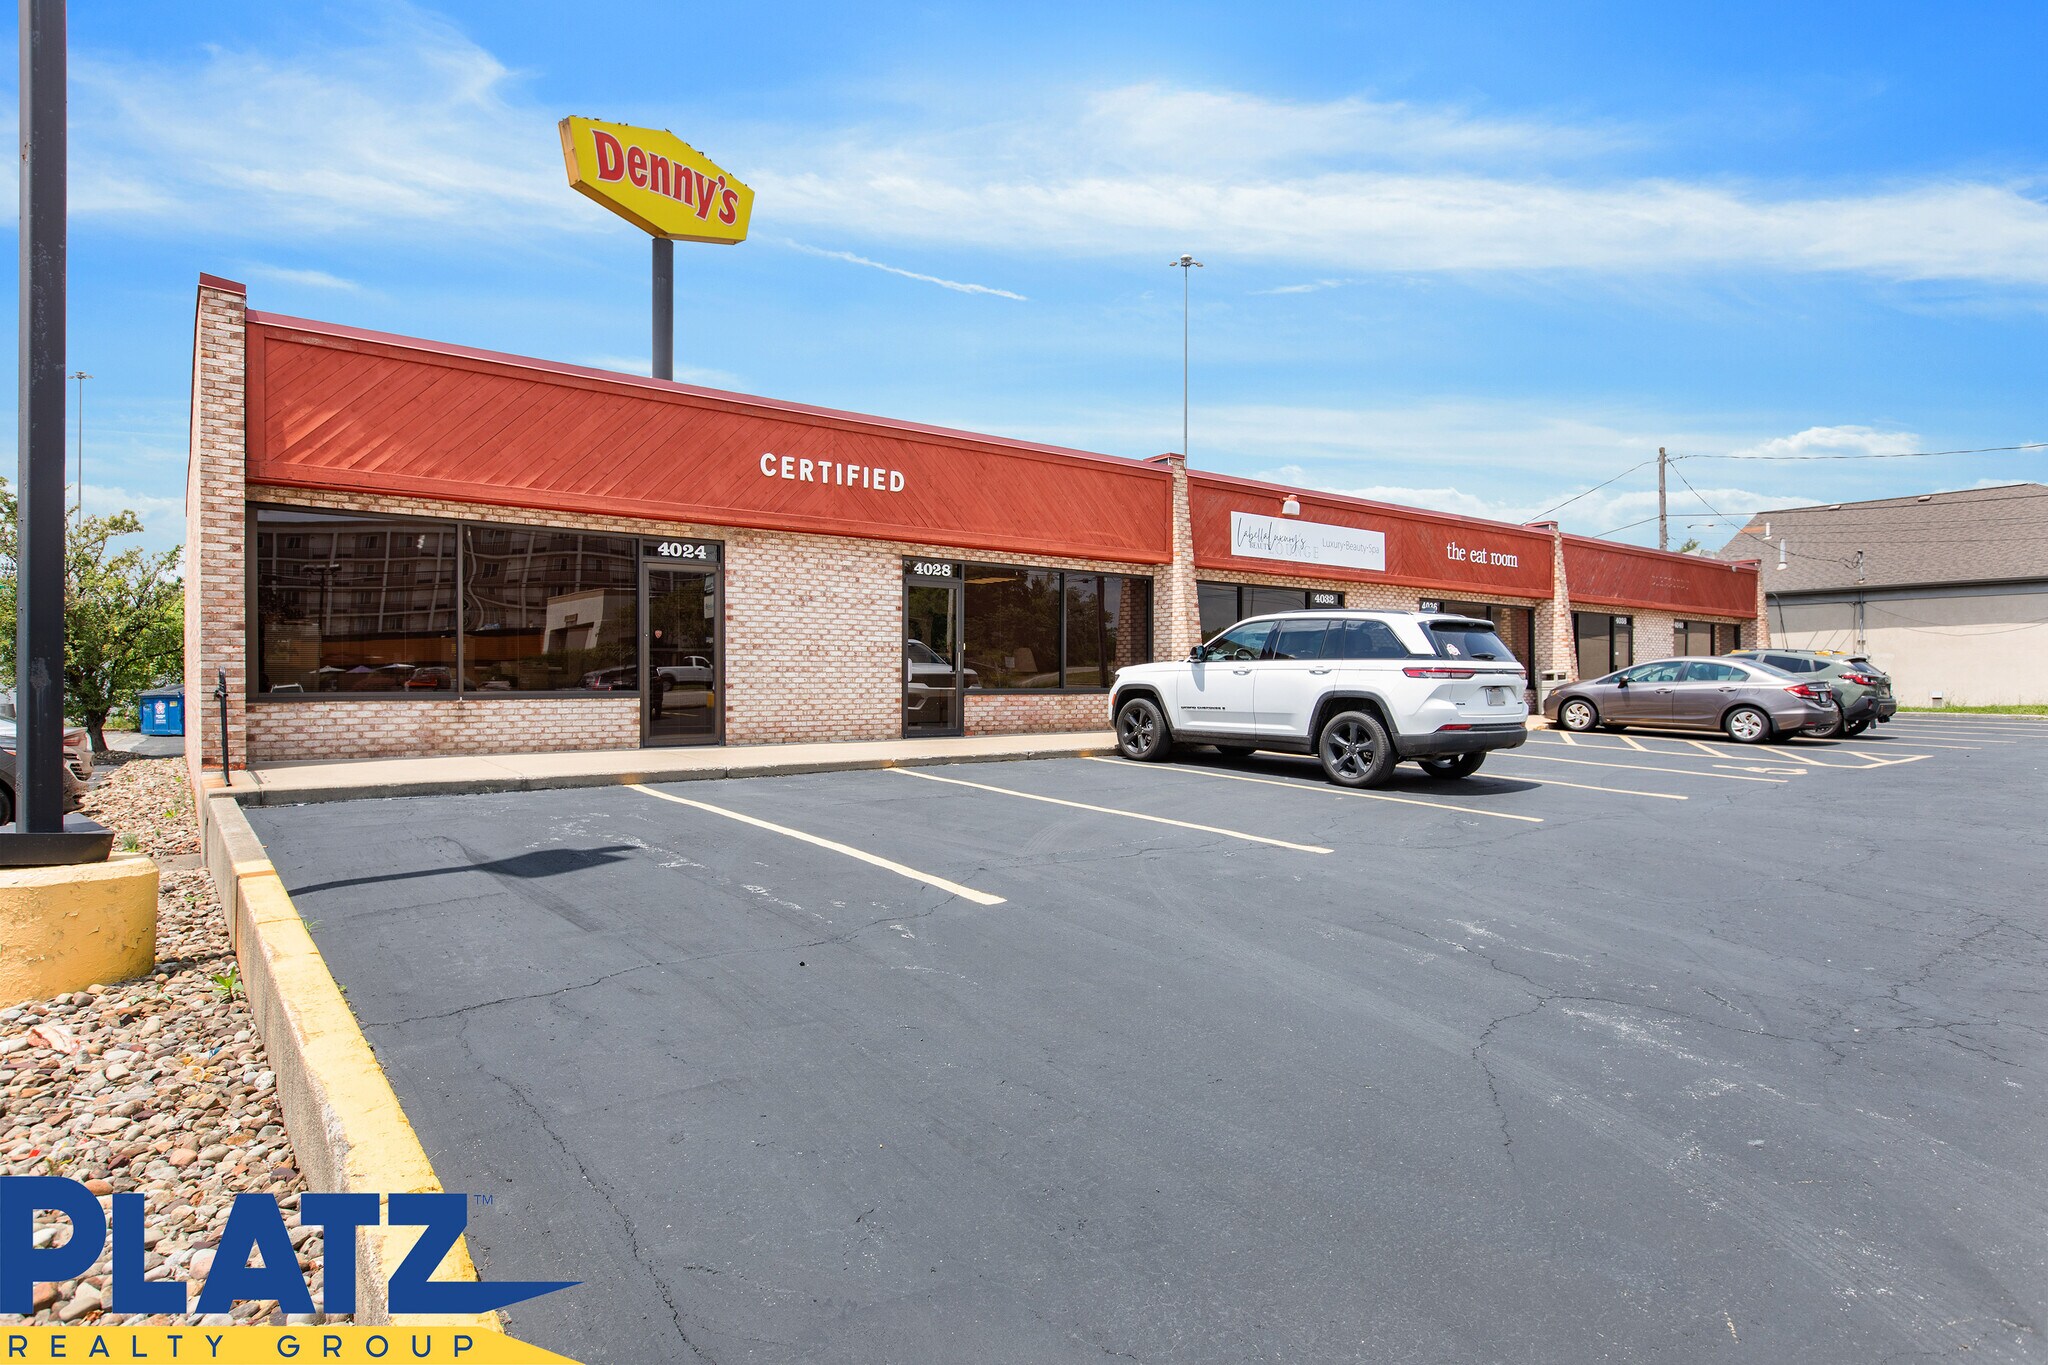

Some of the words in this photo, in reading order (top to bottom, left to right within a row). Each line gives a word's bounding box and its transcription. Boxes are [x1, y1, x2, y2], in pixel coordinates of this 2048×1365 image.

[590, 128, 739, 225] Denny's
[760, 453, 905, 492] CERTIFIED
[657, 542, 707, 559] 4024
[1446, 541, 1466, 561] the
[1470, 548, 1488, 564] eat
[1490, 552, 1518, 568] room
[913, 562, 951, 577] 4028
[1314, 594, 1335, 604] 4032
